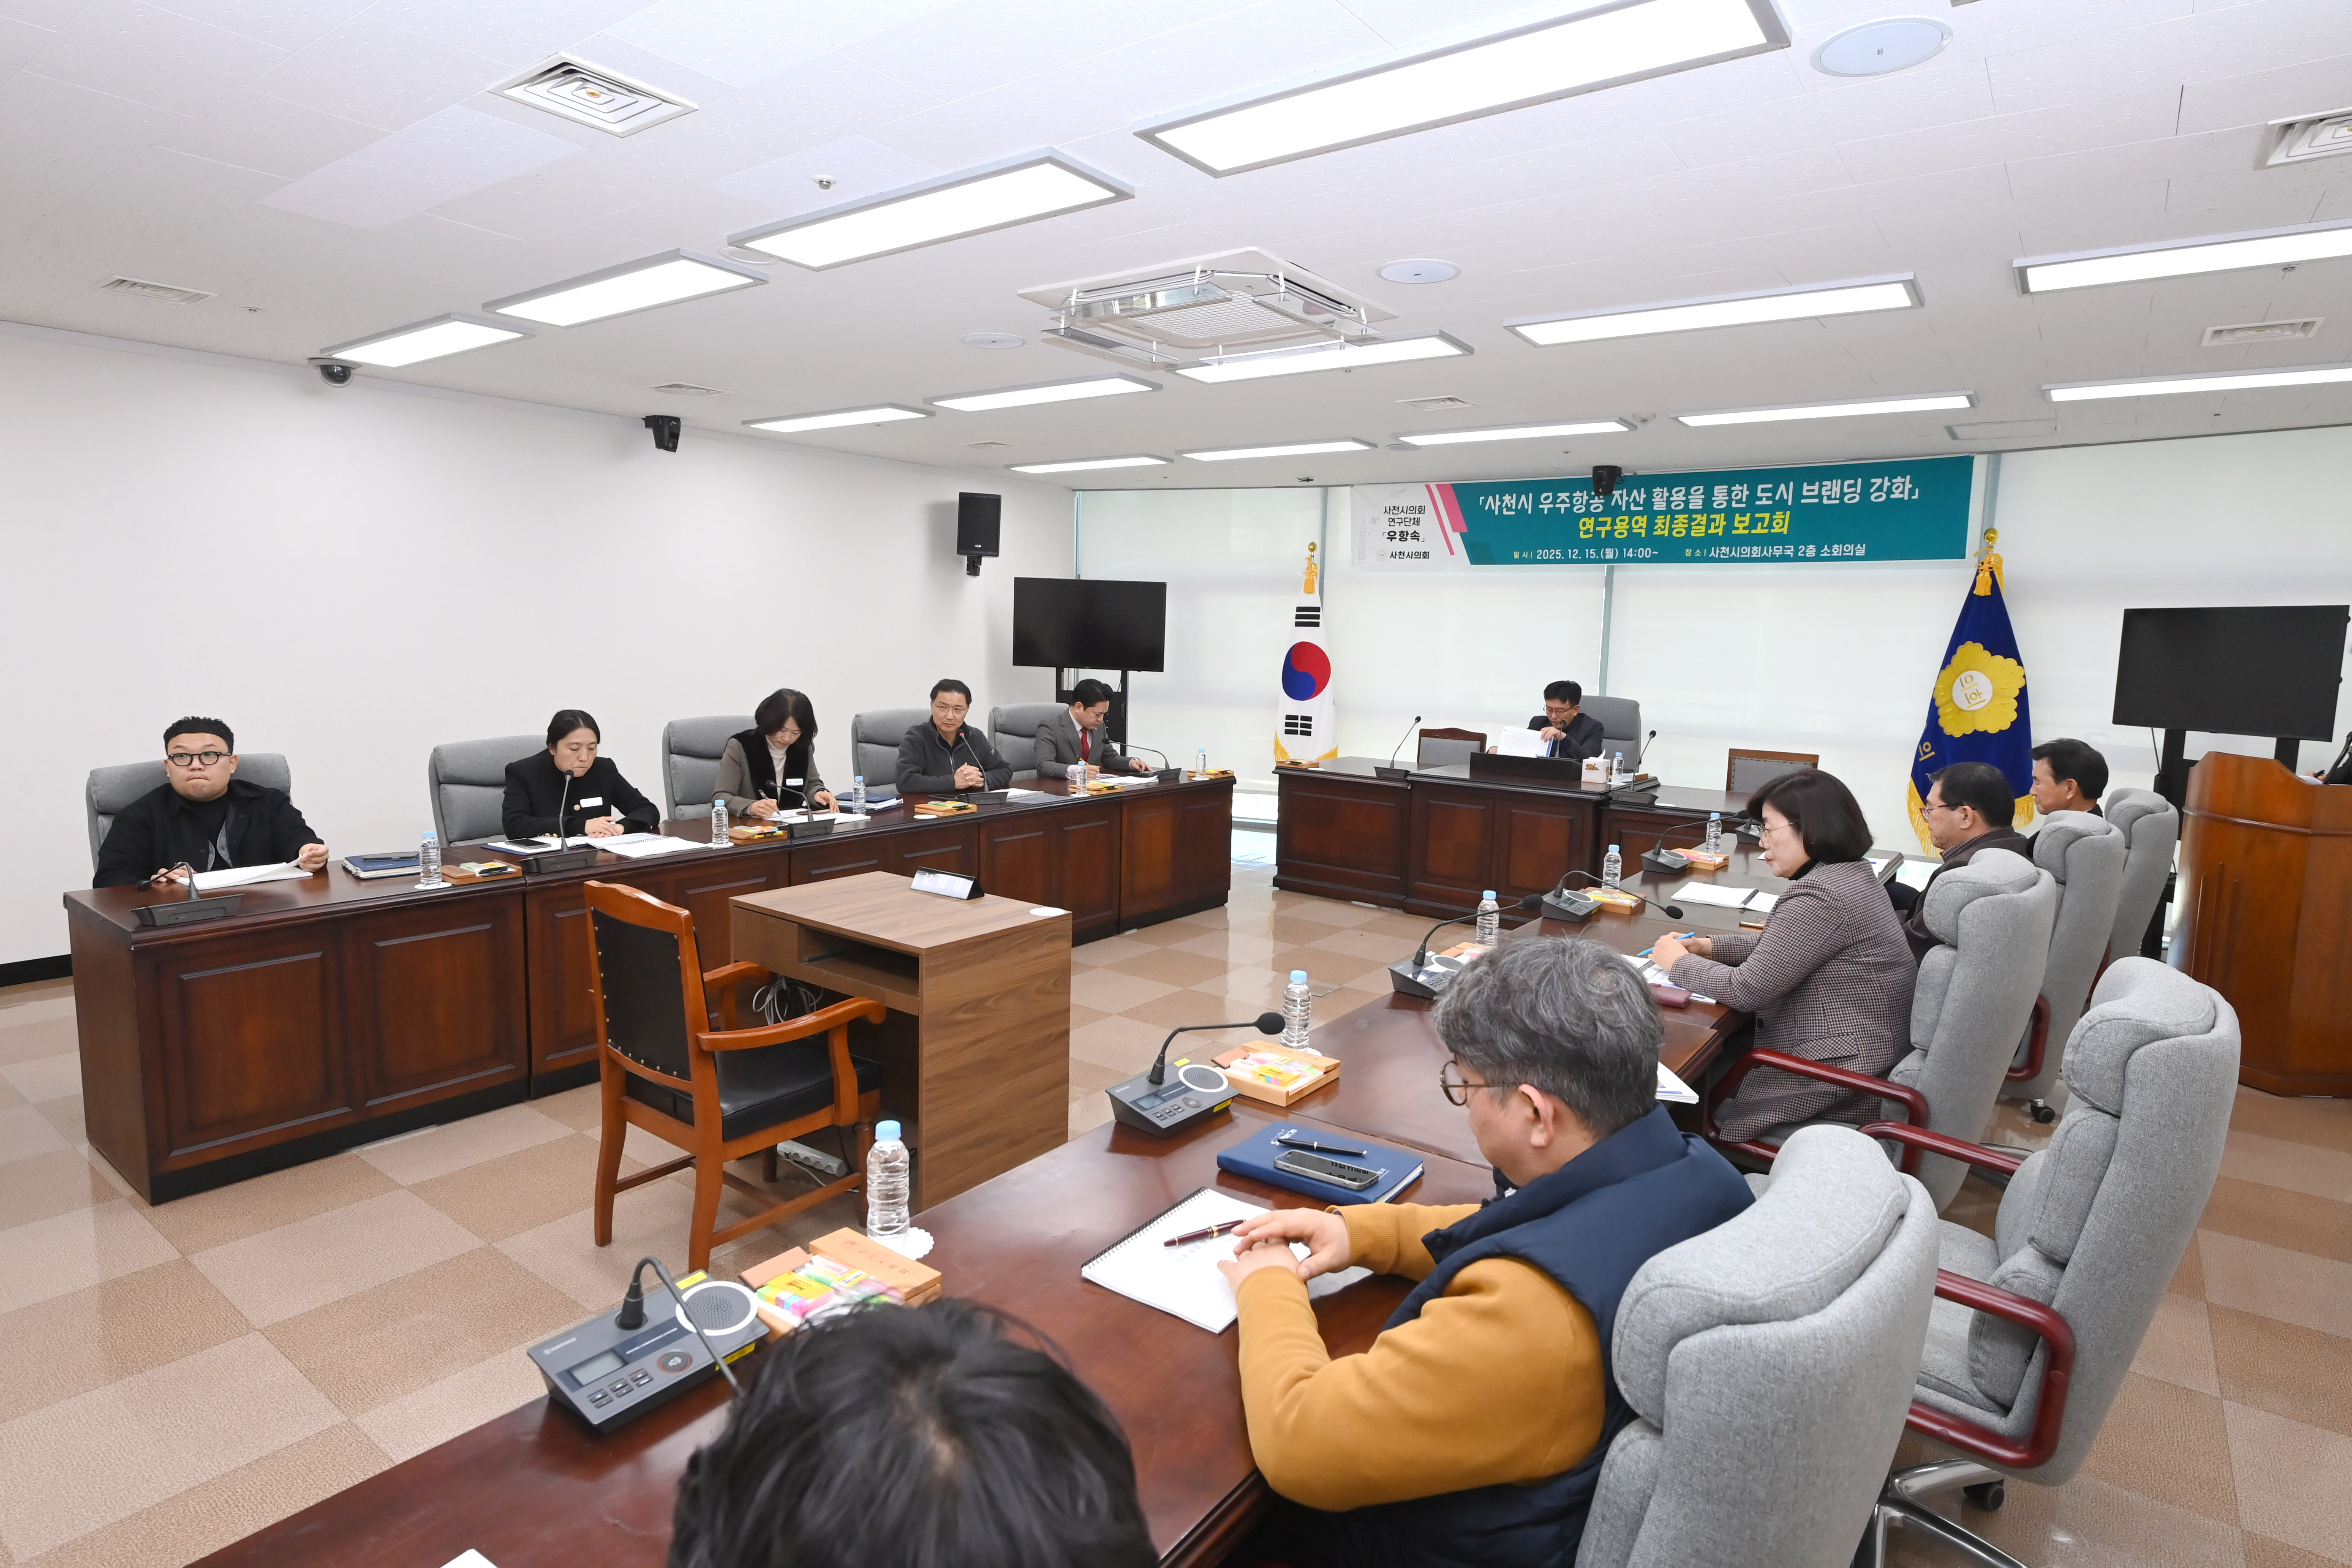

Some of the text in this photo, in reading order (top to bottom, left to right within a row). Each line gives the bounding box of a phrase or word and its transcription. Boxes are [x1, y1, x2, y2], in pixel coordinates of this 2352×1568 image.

[1480, 475, 1919, 515] 「사천시 우주항공 자산 활용을 통한 도시 브랜딩 강화」
[1383, 505, 1425, 514] 사천시의회
[1388, 517, 1420, 526] 연구단체
[1579, 511, 1790, 539] 연구용역 최종결과 보고회
[1389, 551, 1429, 559] 사천시의회
[1536, 549, 1564, 559] 2025.
[1568, 549, 1581, 559] 12.
[1623, 547, 1658, 558] 14:00~
[1709, 545, 1794, 558] 사천시의회사무국
[1798, 545, 1816, 557] 2층
[1820, 544, 1865, 556] 소회의실
